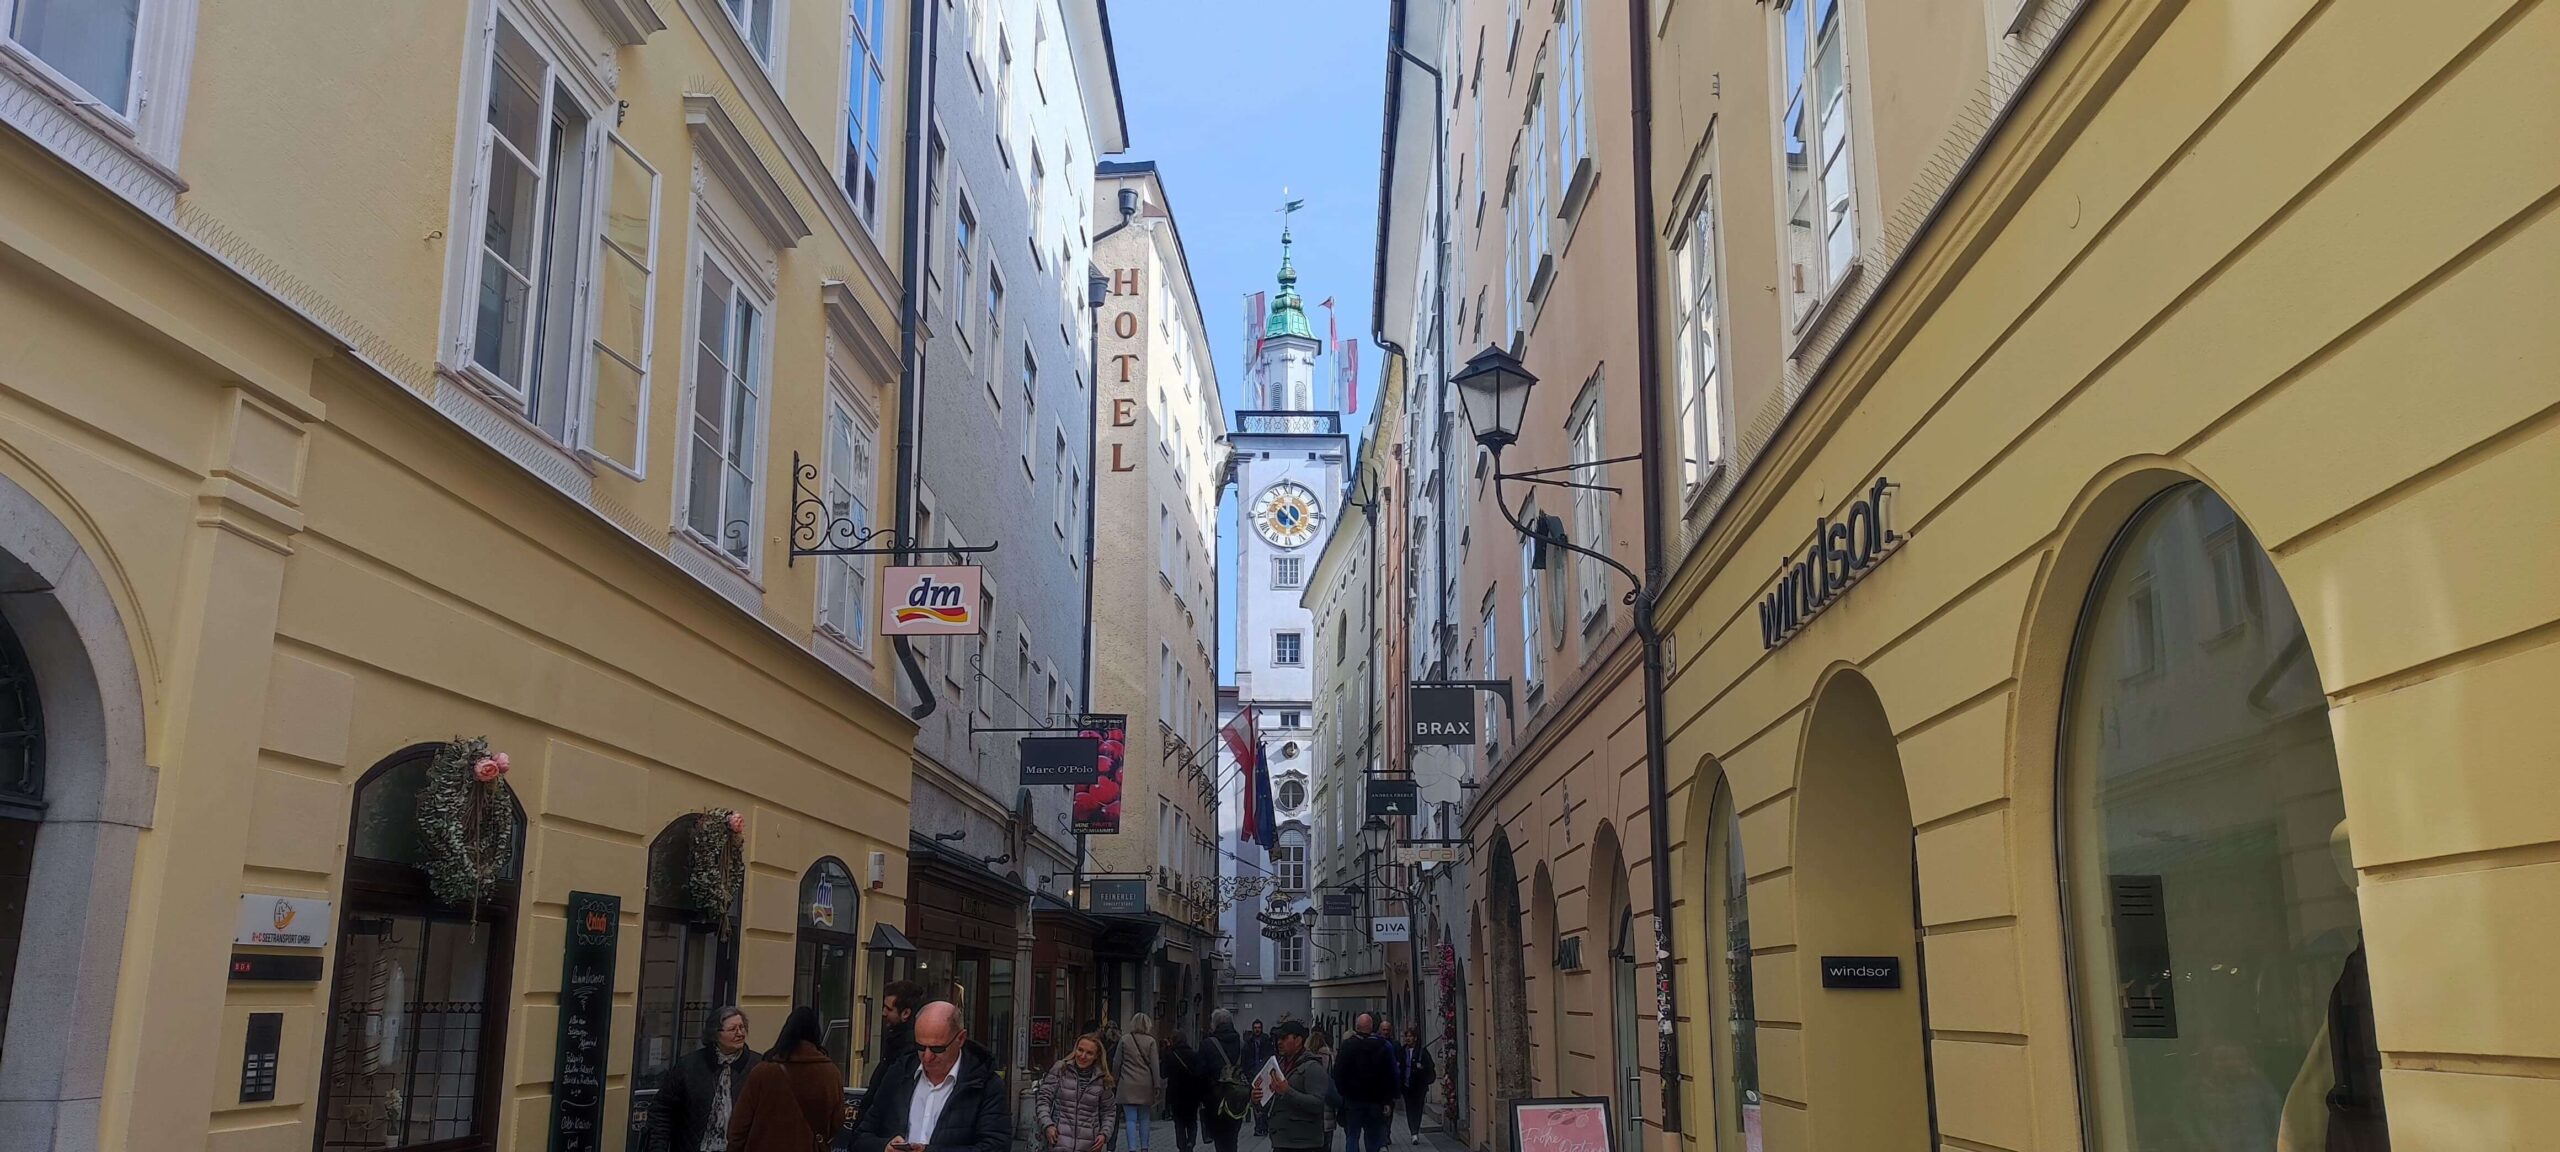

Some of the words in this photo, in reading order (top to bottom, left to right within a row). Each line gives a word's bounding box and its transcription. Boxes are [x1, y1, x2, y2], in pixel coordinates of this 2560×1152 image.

[1111, 268, 1140, 472] HOTEL
[909, 577, 961, 607] dm
[1416, 721, 1470, 735] BRAX
[1025, 765, 1055, 774] Marc
[1057, 765, 1093, 774] O'Polo
[1375, 923, 1406, 932] DIVA
[262, 933, 298, 944] SEETRANSPORT
[1830, 966, 1891, 977] windsor
